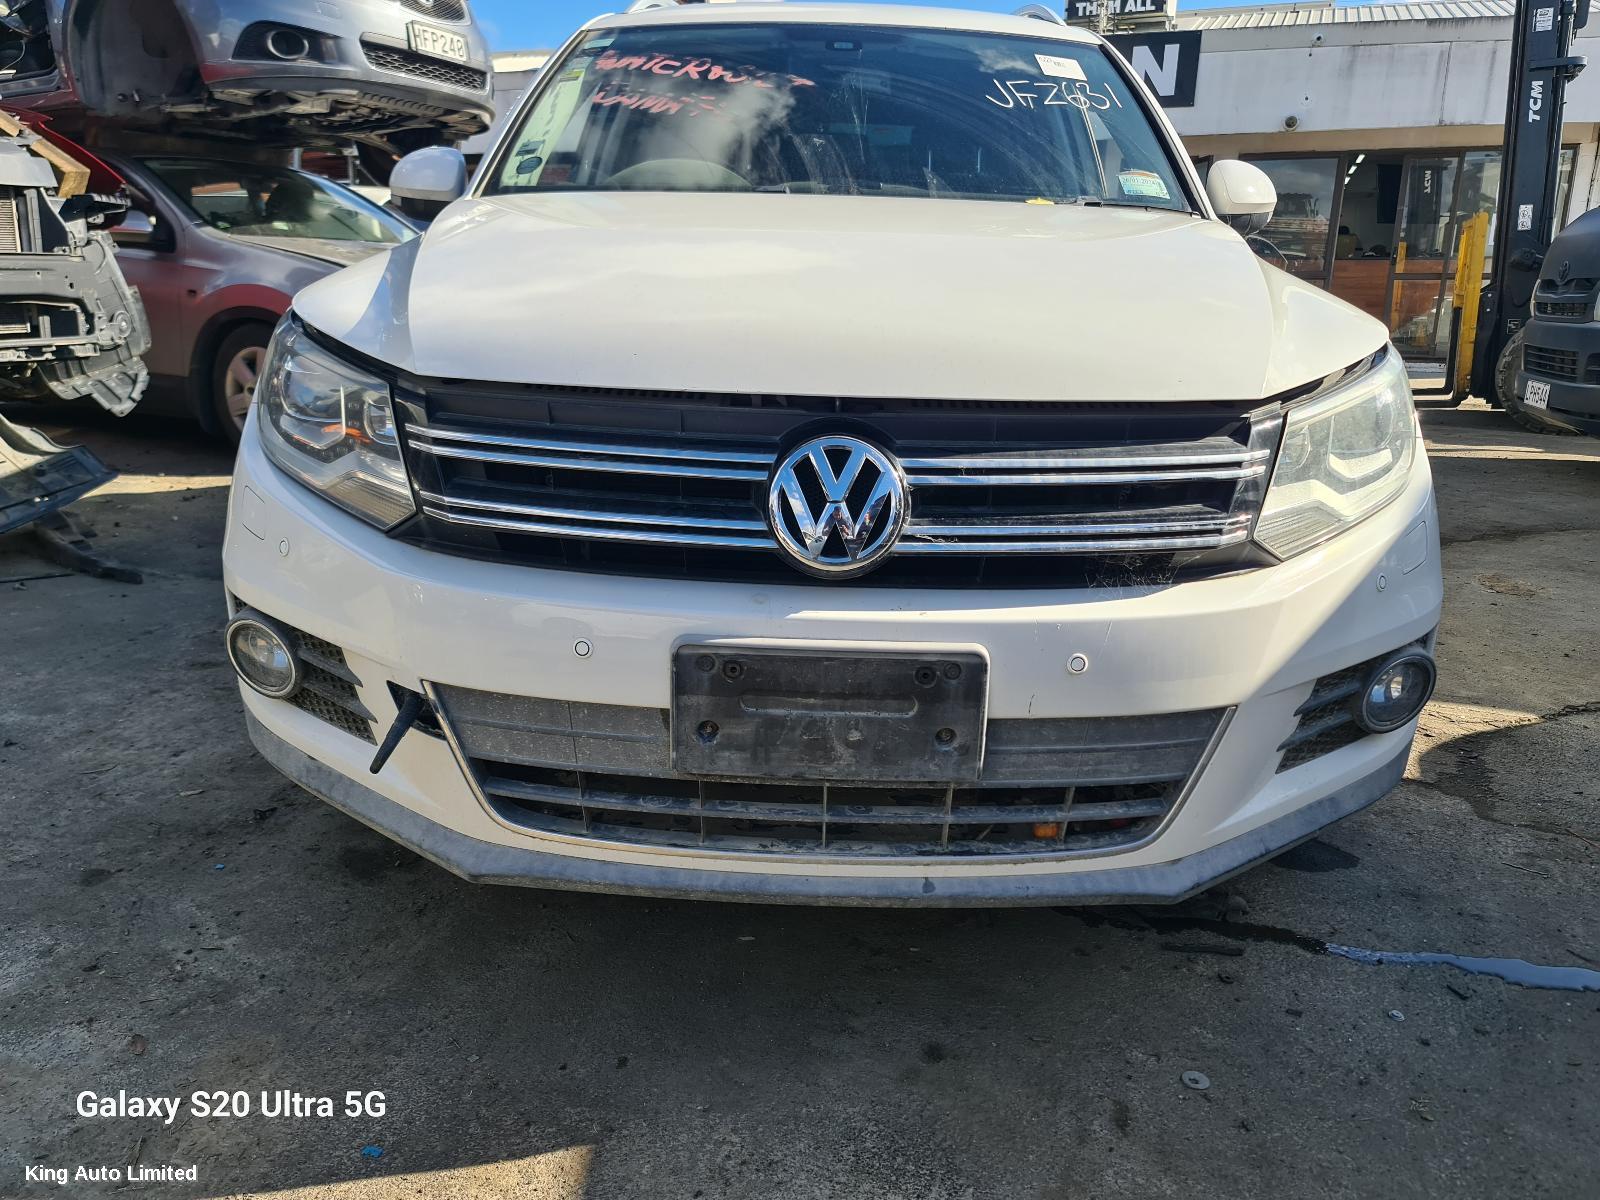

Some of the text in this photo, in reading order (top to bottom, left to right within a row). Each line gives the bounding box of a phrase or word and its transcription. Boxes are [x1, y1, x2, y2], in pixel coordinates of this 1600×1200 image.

[1075, 0, 1156, 17] THM ALL
[1528, 80, 1544, 123] TCM
